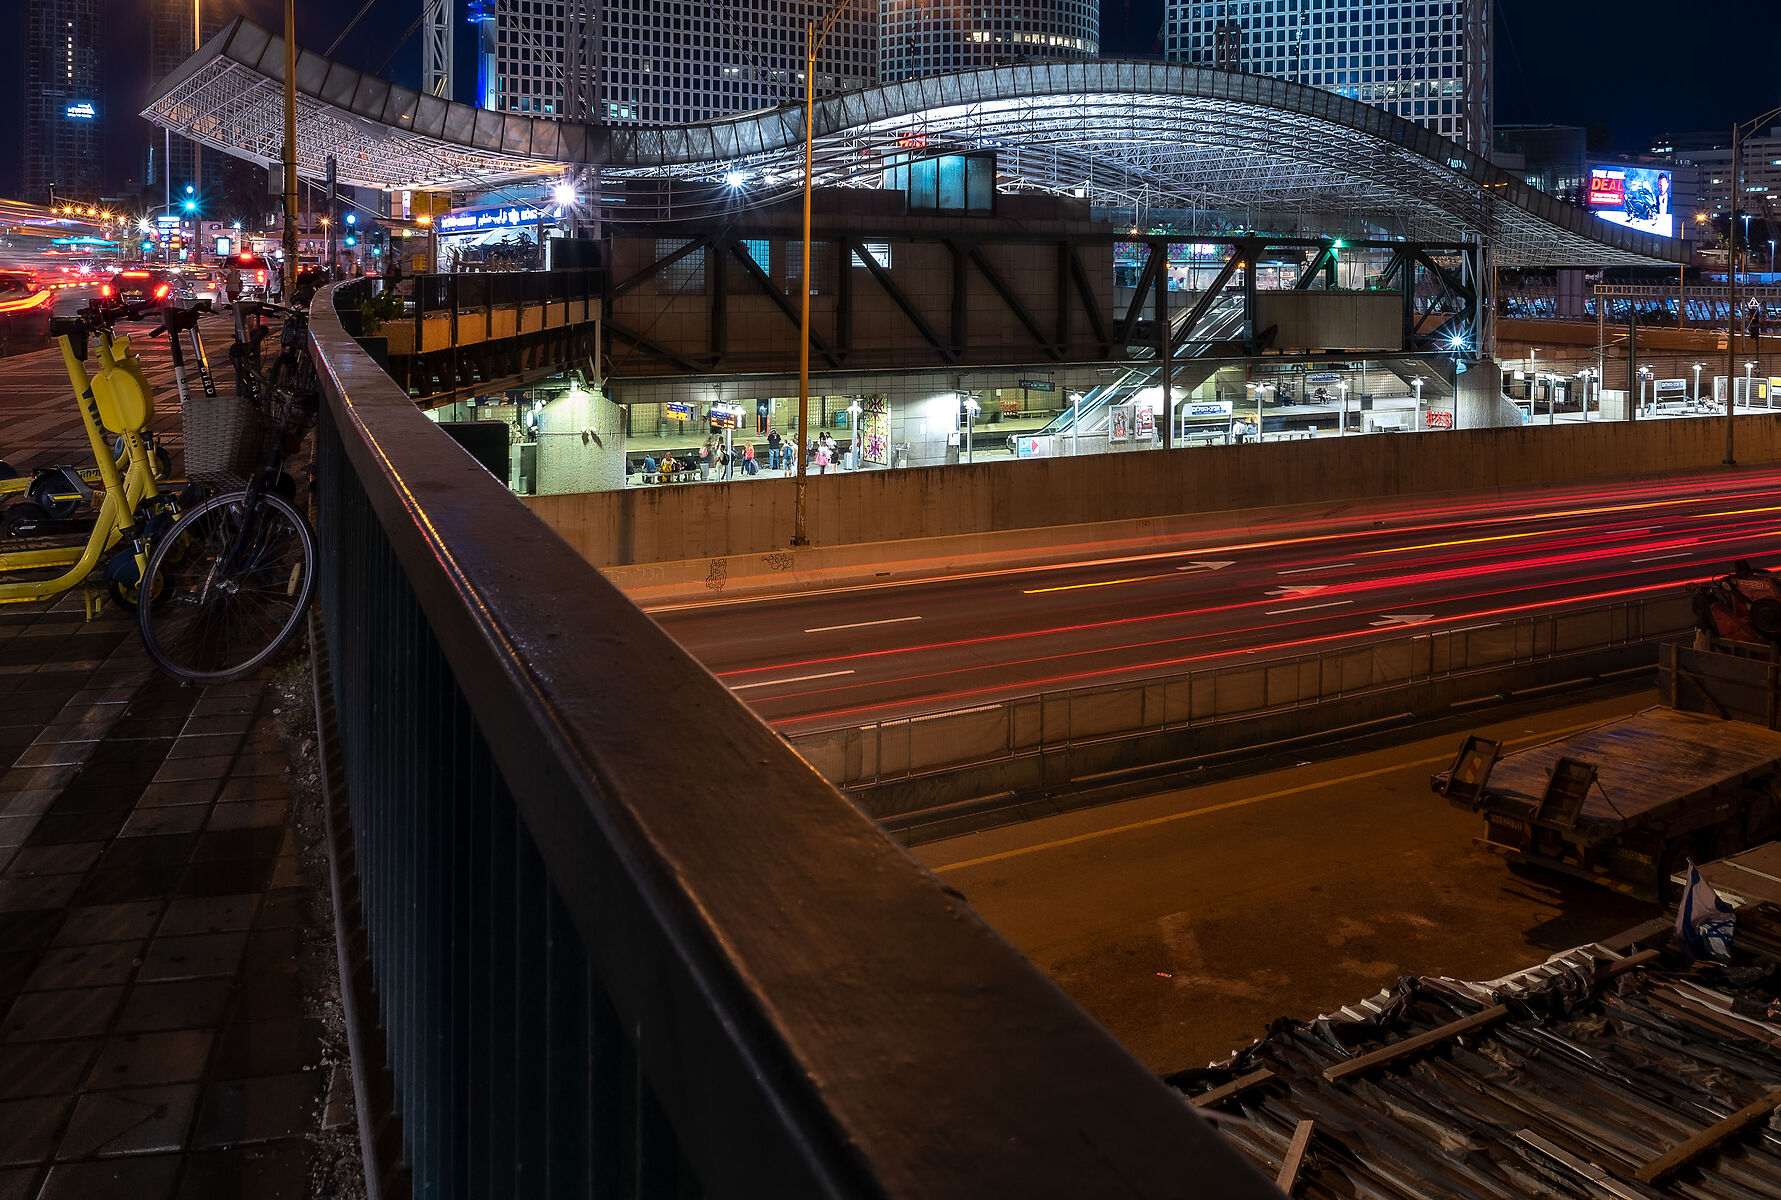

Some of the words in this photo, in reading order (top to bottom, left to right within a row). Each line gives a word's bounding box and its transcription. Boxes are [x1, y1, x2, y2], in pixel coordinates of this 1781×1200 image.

[1591, 178, 1624, 192] DEAL
[180, 377, 191, 401] BIR
[200, 367, 214, 394] BIRD
